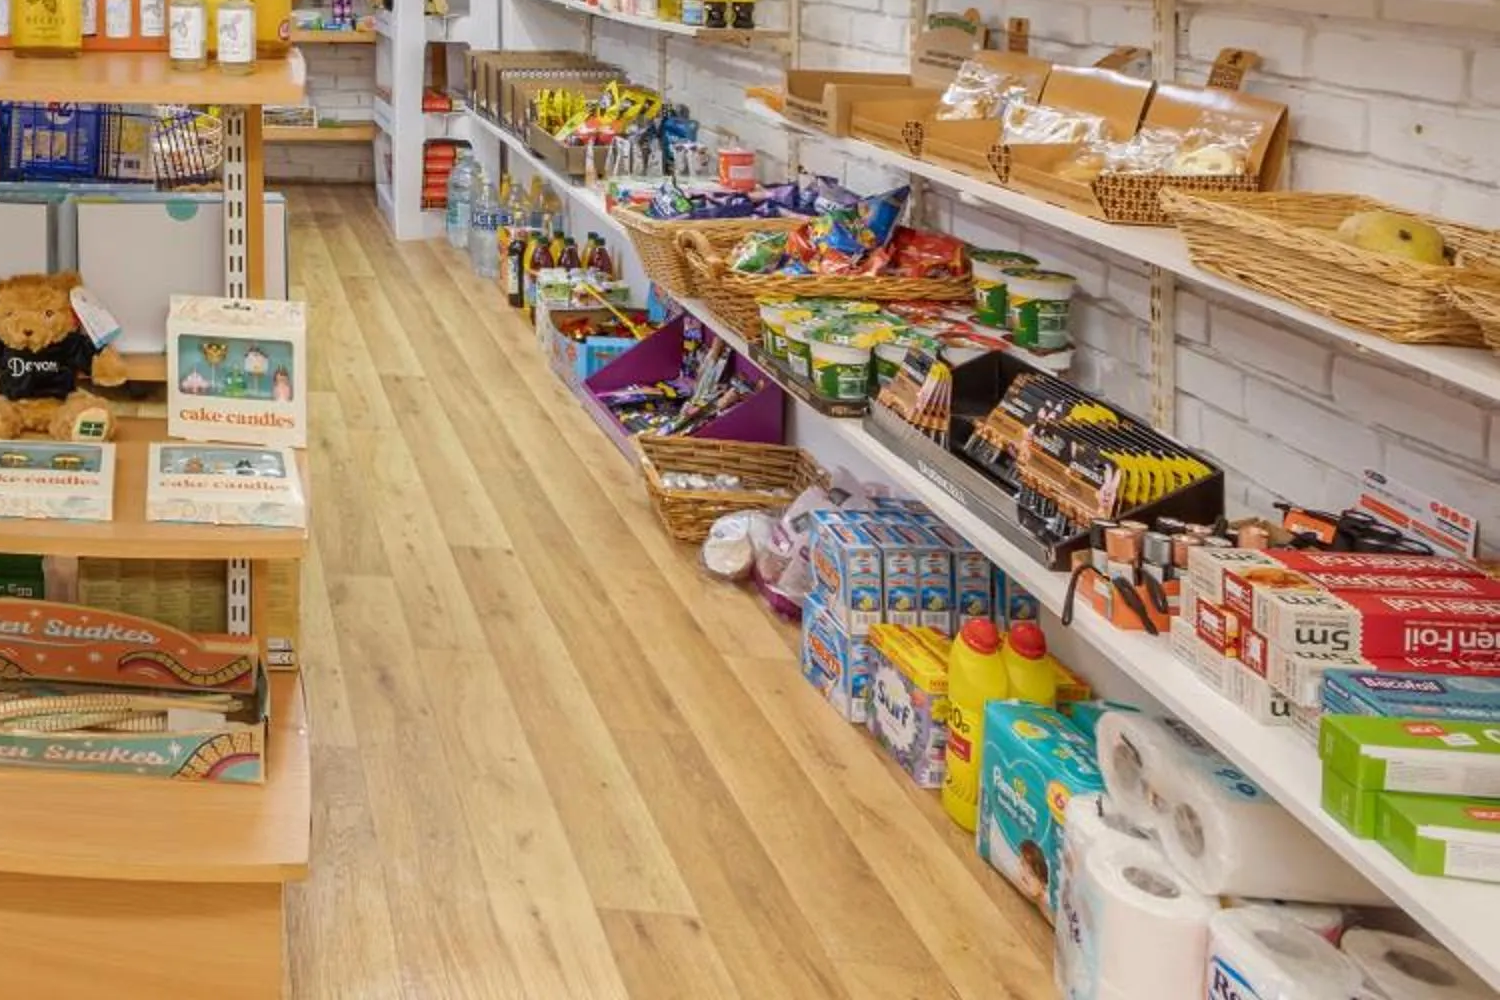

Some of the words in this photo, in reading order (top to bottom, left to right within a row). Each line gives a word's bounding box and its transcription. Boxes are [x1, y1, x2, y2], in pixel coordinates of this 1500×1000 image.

[179, 407, 224, 423] cake
[225, 411, 296, 430] candles
[42, 618, 160, 646] Snakes
[1295, 627, 1350, 652] 5m
[1405, 627, 1453, 651] Foil
[42, 738, 170, 767] Snakes
